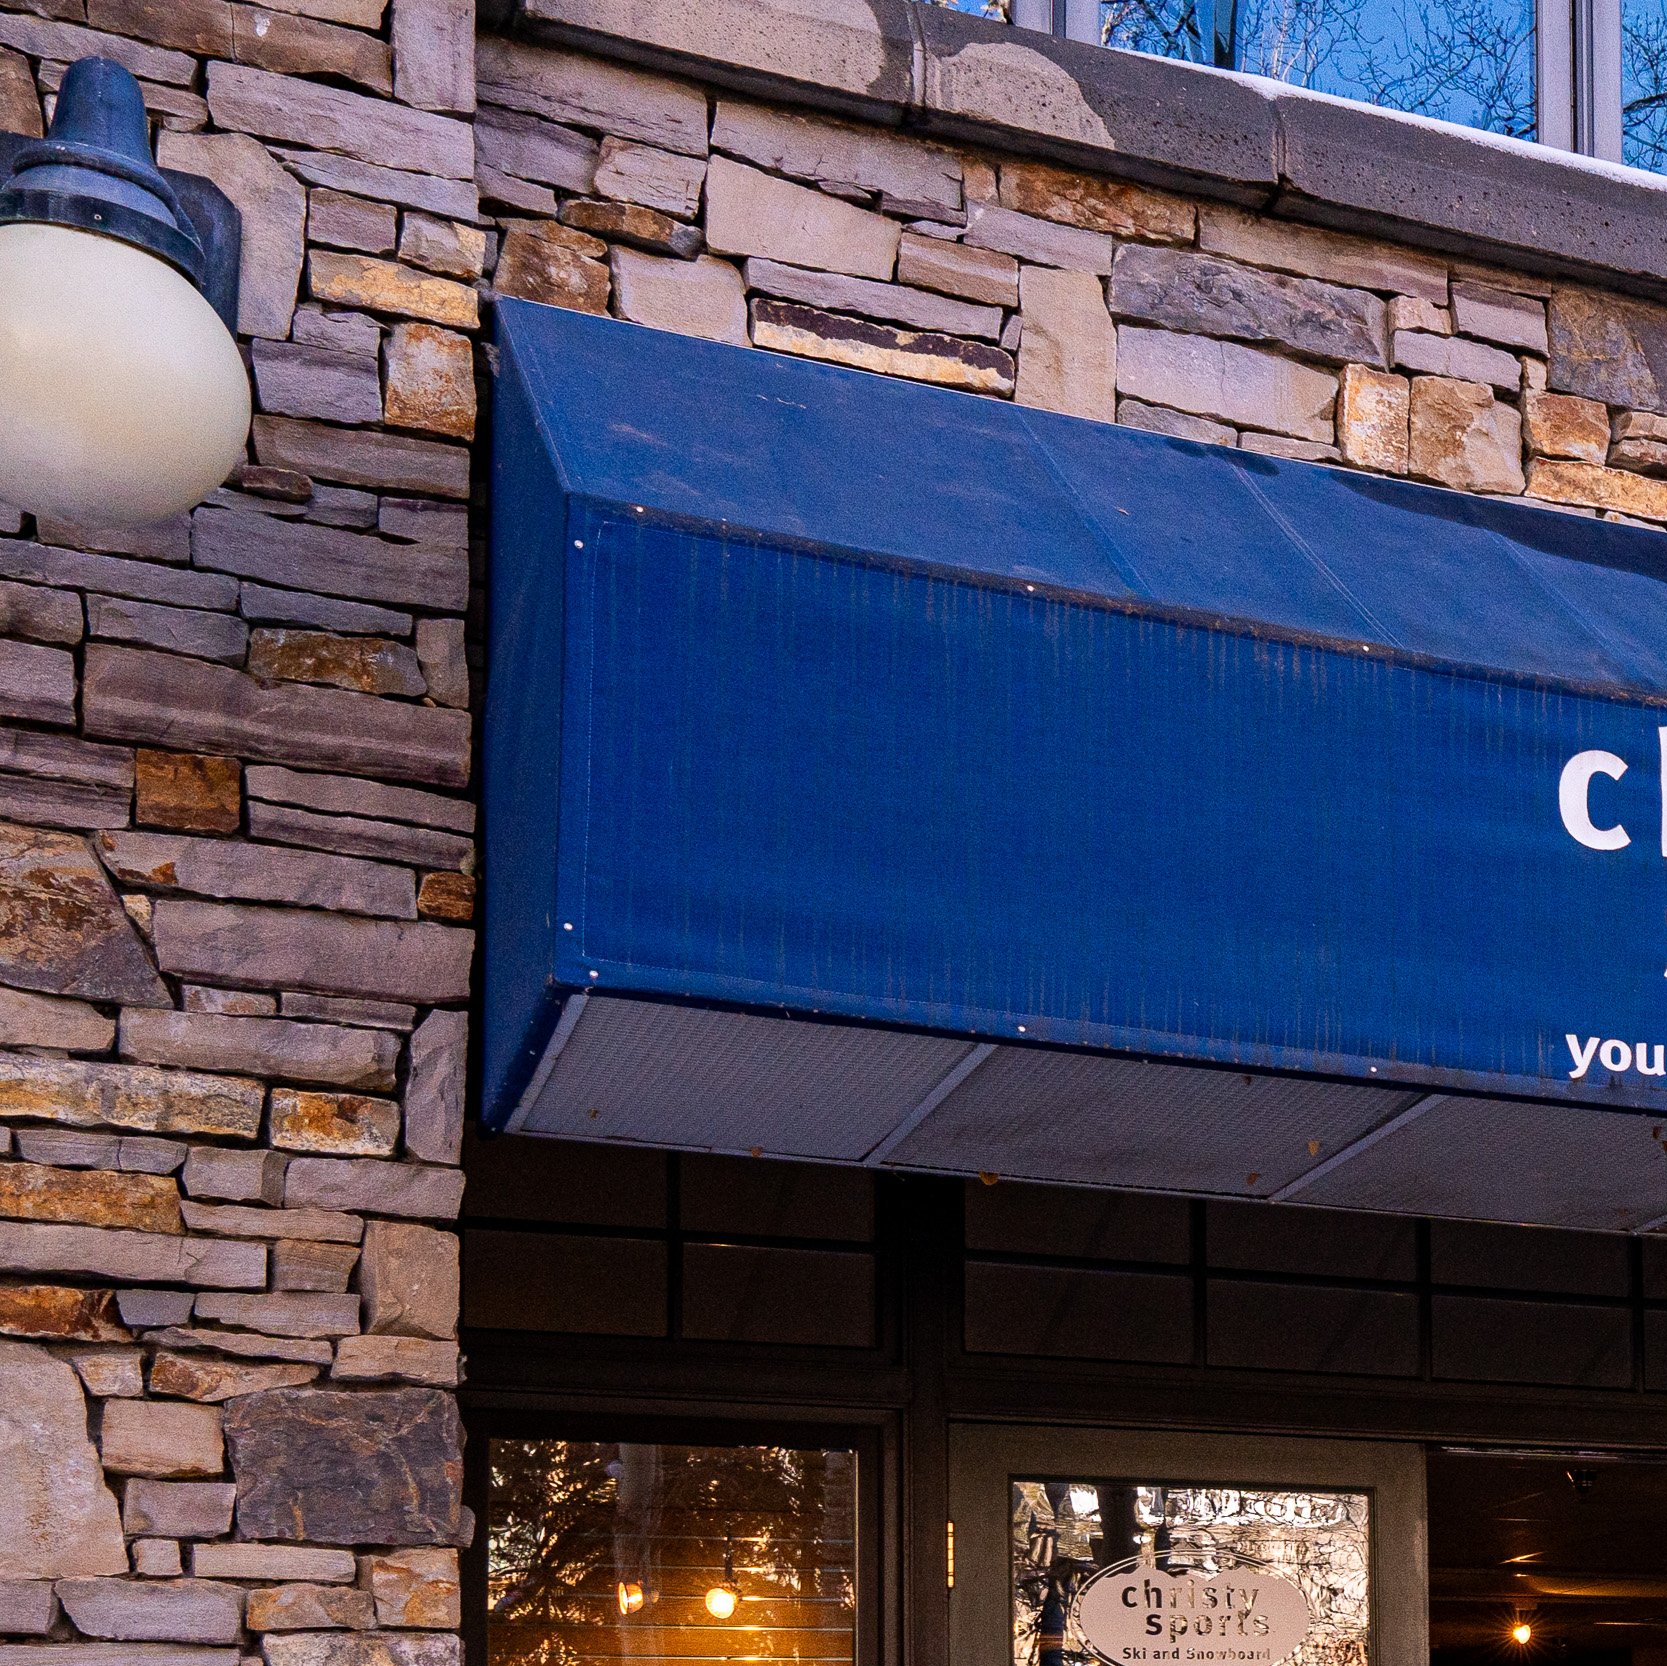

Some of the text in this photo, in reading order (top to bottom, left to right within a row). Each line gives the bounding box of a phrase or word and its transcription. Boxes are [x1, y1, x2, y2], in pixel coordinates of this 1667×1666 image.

[1121, 1579, 1259, 1614] christy
[1145, 1611, 1270, 1643] sports
[1122, 1647, 1271, 1660] Ski and Snowboard
